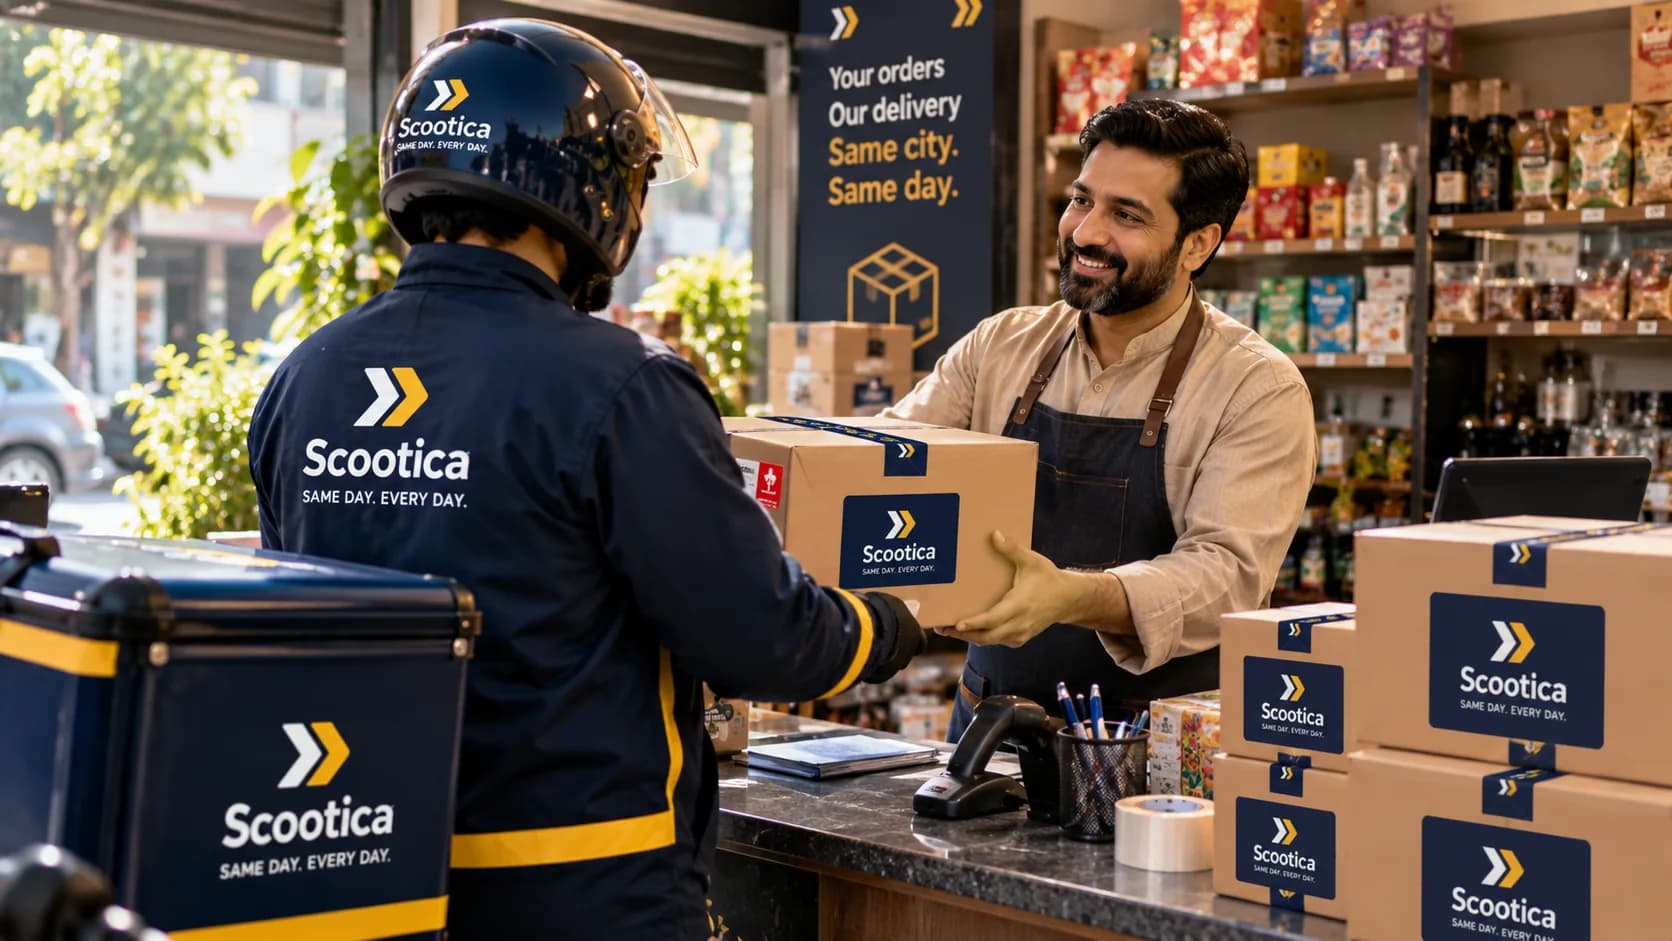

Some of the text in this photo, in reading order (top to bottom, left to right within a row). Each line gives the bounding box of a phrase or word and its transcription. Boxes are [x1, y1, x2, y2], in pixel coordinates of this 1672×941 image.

[828, 55, 945, 91] Your orders
[828, 92, 962, 128] Our delivery
[398, 115, 492, 139] Scootica
[397, 140, 489, 154] SAME DAY. EVERY DAY.
[828, 128, 959, 167] Same city.
[828, 169, 959, 207] Same day.
[302, 437, 471, 480] Scootica
[302, 489, 468, 508] SAME DAY. EVERY DAY.
[862, 542, 936, 564] Scootica
[862, 564, 936, 576] SAME DAY. EVERY DAY.
[1460, 665, 1567, 704] Scootica
[1261, 702, 1324, 727] Scootica
[1460, 699, 1567, 722] SAME DAY. EVERY DAY.
[1261, 723, 1325, 738] SAME DAY. EVERY DAY.
[221, 794, 394, 849] Scootica
[219, 847, 392, 880] SAME DAY. EVERY DAY.
[1253, 844, 1316, 872] Scootica
[1253, 864, 1269, 874] SAME
[1282, 870, 1302, 880] EVERY
[1451, 886, 1556, 930] Scootica
[1451, 917, 1477, 931] SAME
[1478, 923, 1499, 936] DAY.
[1501, 927, 1532, 941] EVERY
